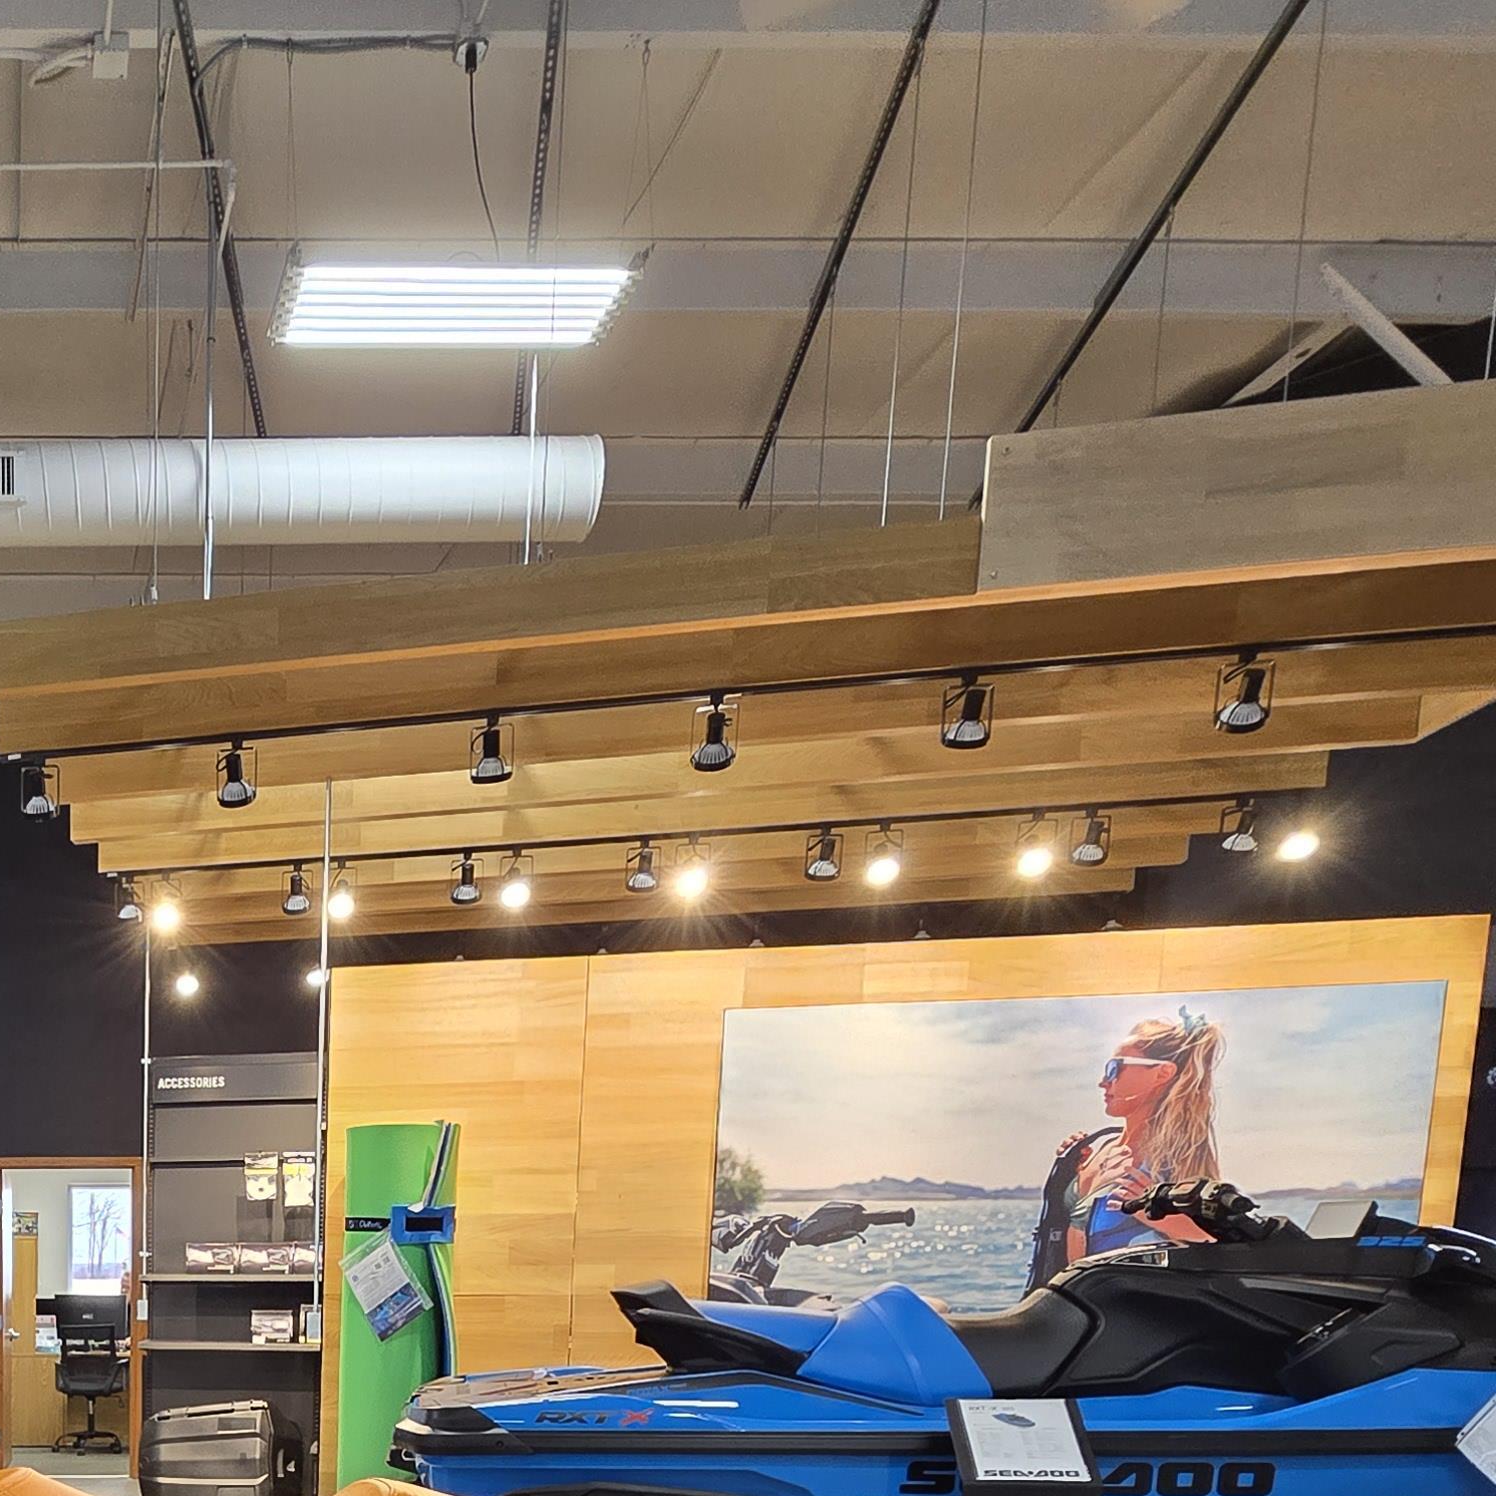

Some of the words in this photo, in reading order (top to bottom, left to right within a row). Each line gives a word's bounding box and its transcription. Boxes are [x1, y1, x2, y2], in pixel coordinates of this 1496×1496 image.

[157, 1075, 226, 1090] ACCESSORIES
[535, 1410, 609, 1425] RXT
[620, 1408, 655, 1428] X
